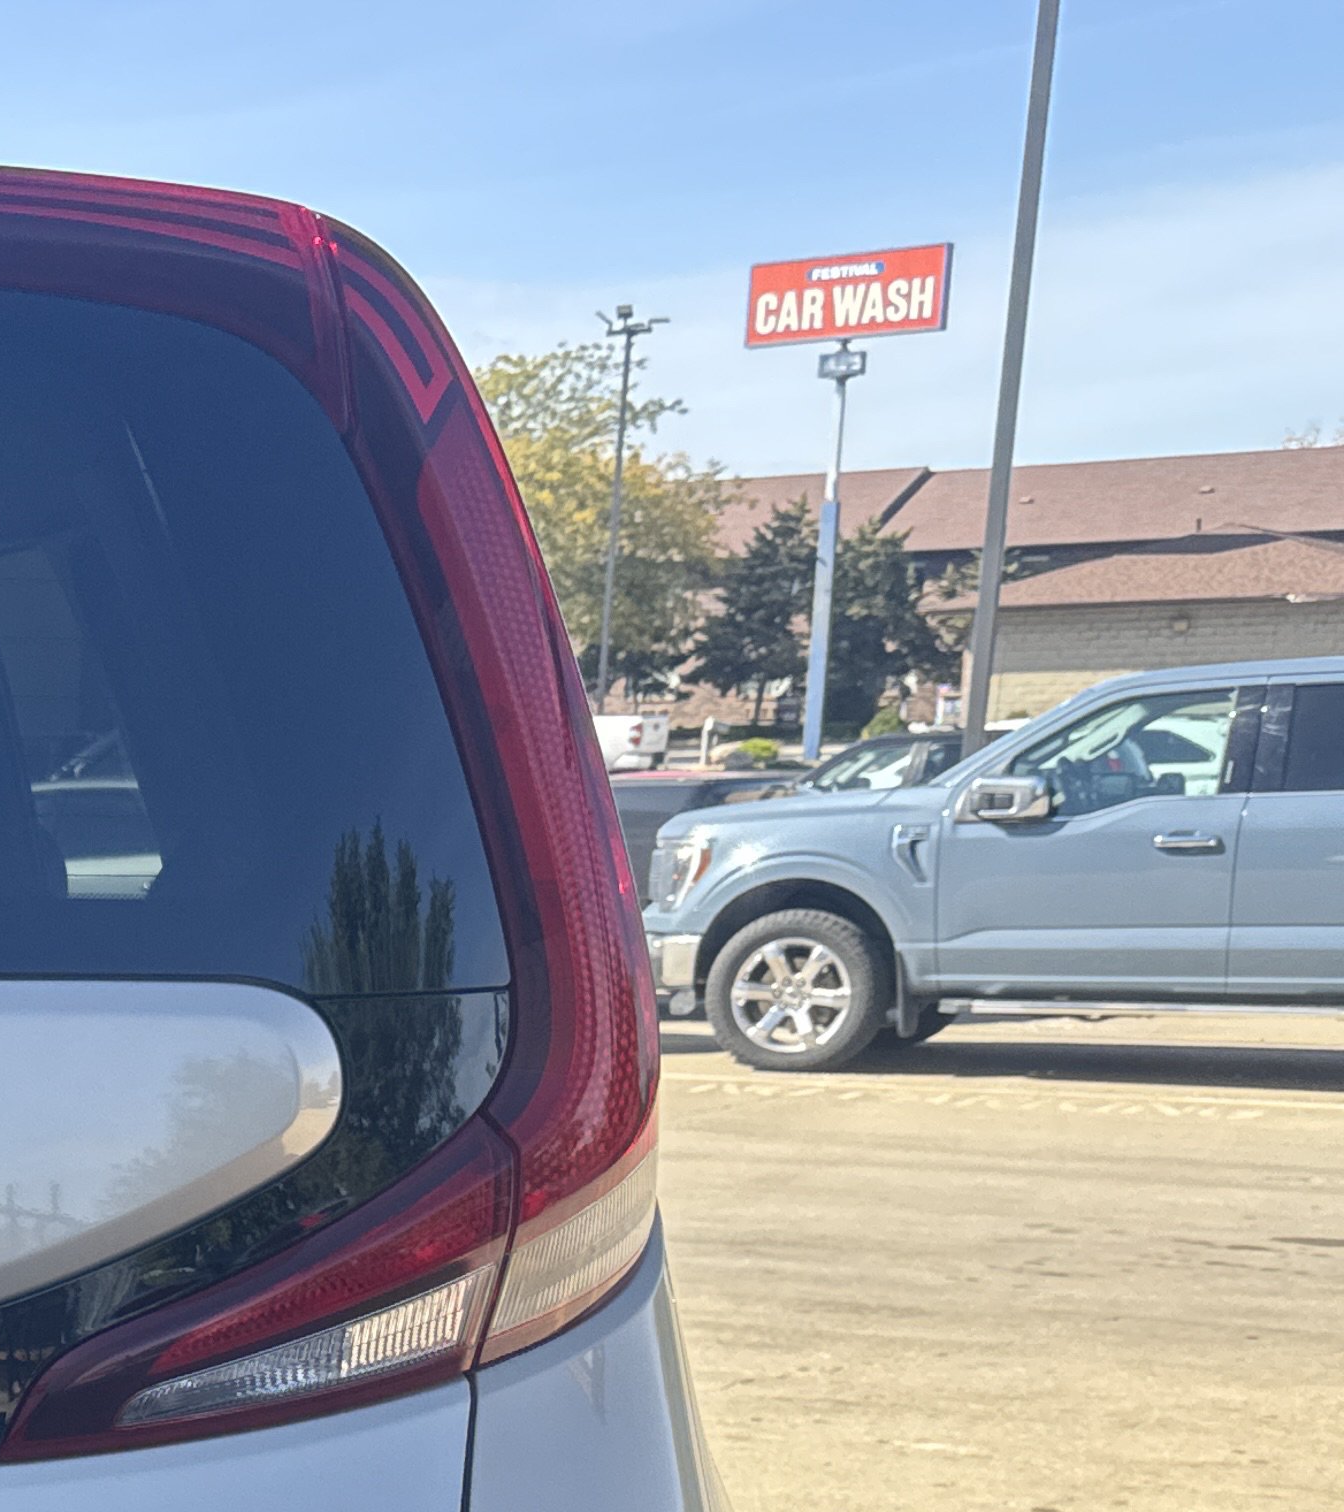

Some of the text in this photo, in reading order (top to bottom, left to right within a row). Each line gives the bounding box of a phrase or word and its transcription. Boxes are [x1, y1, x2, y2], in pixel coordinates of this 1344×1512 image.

[811, 262, 879, 281] FESTIVAL
[754, 276, 936, 335] CAR WASH
